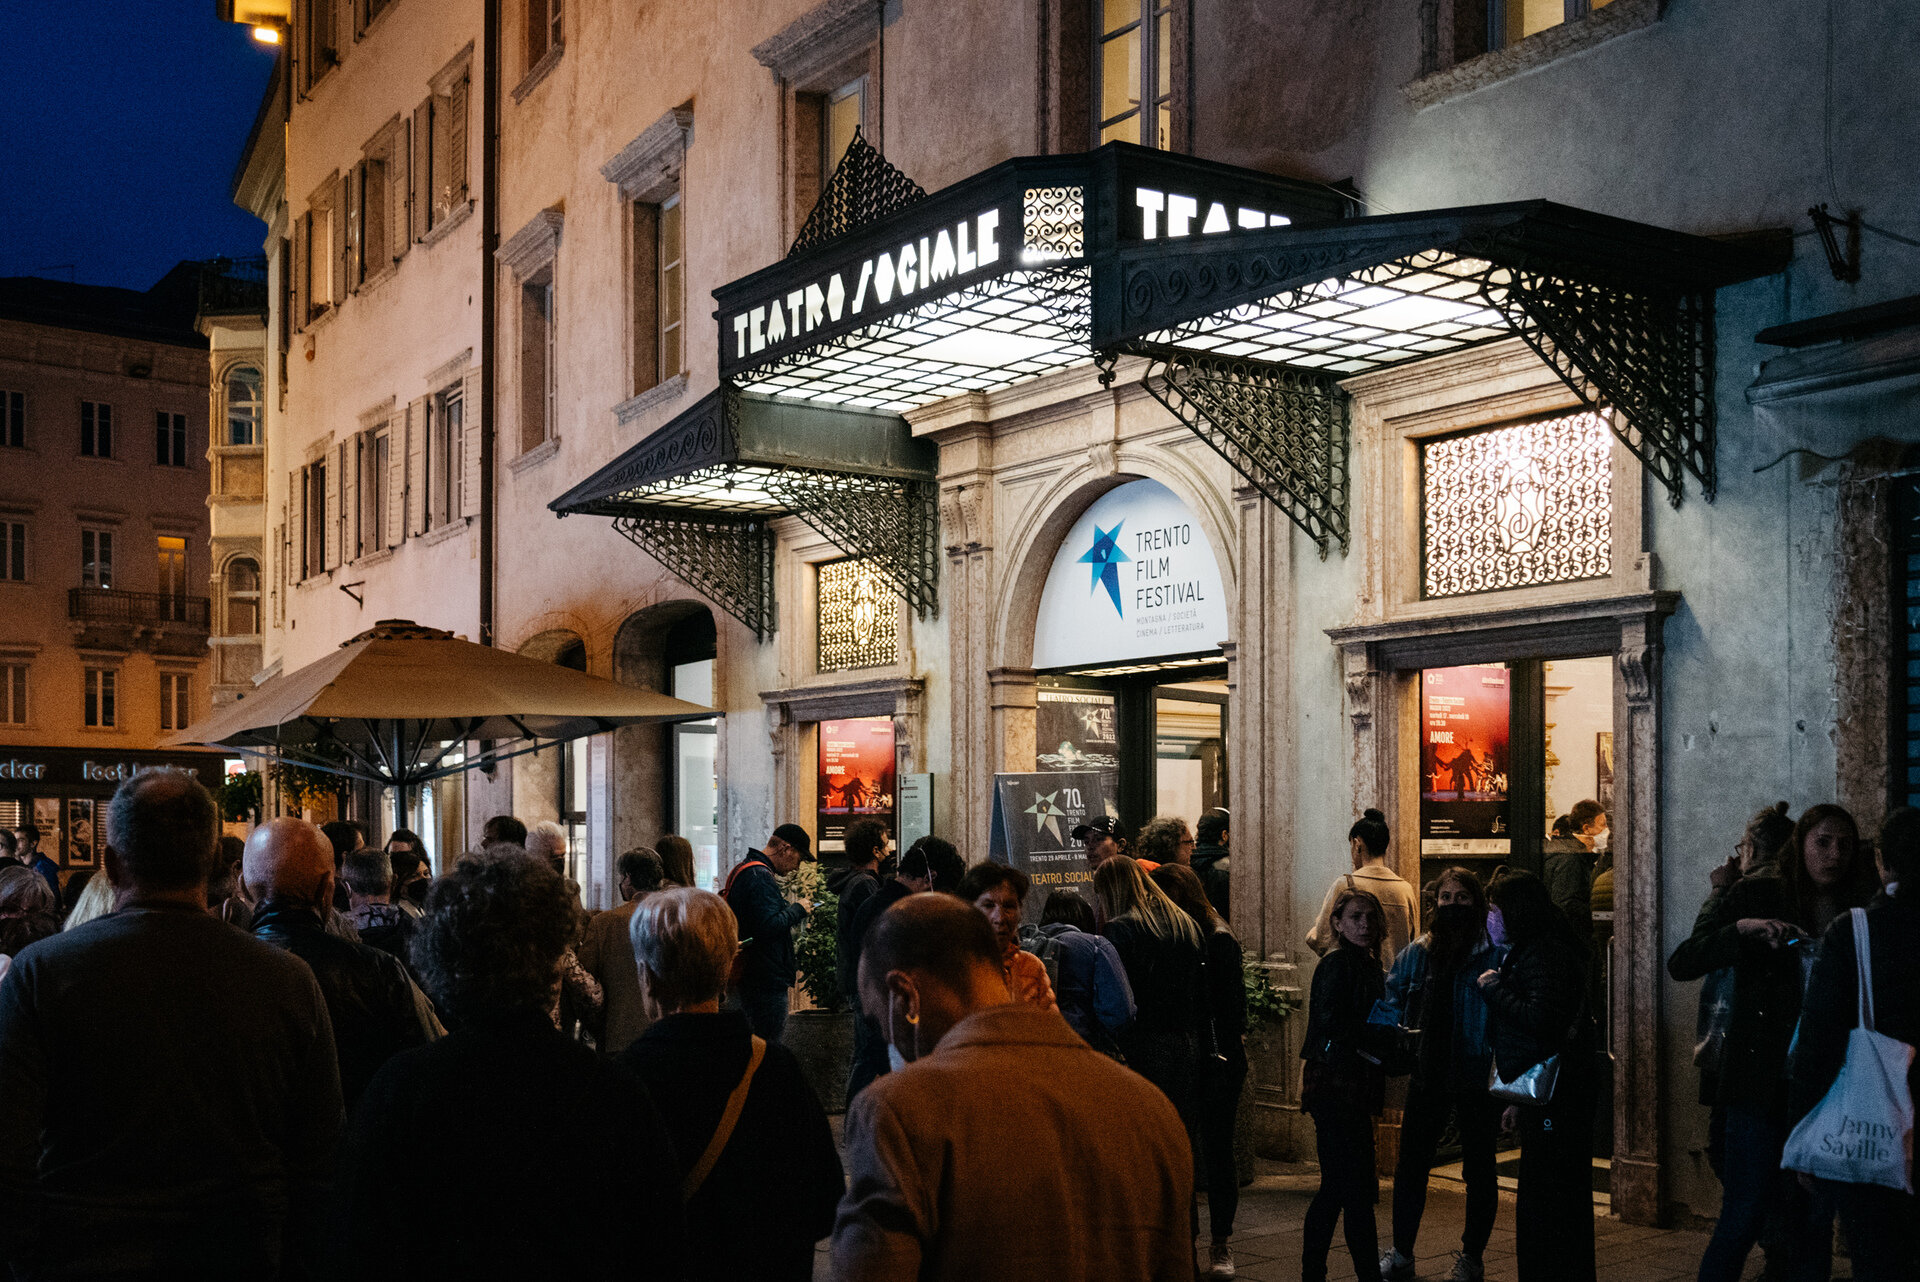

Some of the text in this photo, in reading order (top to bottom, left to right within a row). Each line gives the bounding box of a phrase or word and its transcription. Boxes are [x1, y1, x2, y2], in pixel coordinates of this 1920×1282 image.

[733, 207, 999, 359] TEATRO SOCIALE
[1136, 523, 1190, 553] TRENTO
[1136, 556, 1169, 581] FILM
[1136, 580, 1205, 610] FESTIVAL
[1136, 614, 1167, 625] MONTAGNA
[1173, 607, 1198, 621] SOCIETÀ
[1136, 628, 1158, 638] CINEMA
[1164, 622, 1205, 635] LETTERATURA
[1429, 731, 1454, 744] AMORE
[1063, 788, 1085, 809] 70.
[1030, 871, 1095, 885] TEATRO SOCIAL
[1836, 1115, 1899, 1146] Jenny
[1819, 1132, 1890, 1163] Saville
